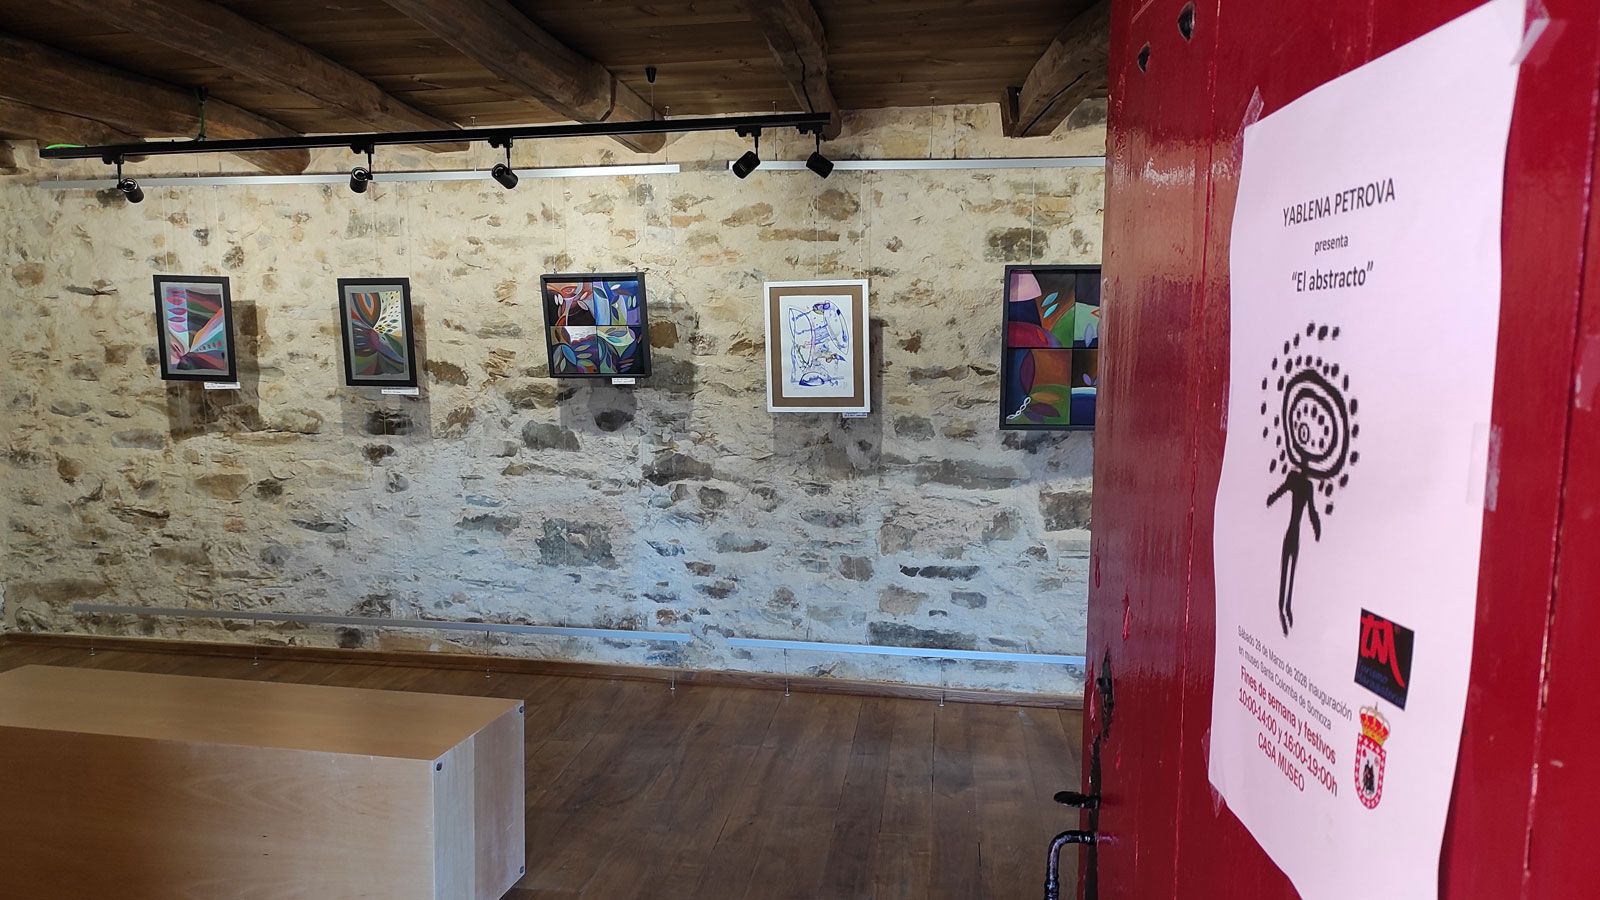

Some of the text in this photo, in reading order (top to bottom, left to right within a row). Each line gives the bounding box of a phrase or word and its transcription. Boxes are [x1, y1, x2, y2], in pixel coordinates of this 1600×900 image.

[1283, 178, 1395, 227] YABLENA PETROVA
[1314, 234, 1349, 255] presenta
[1238, 645, 1244, 656] en
[1275, 673, 1297, 702] Colomba
[1299, 694, 1305, 709] de
[1307, 700, 1331, 730] Somoza
[1262, 645, 1268, 658] de
[1269, 648, 1284, 670] Marzo
[1285, 662, 1292, 677] de
[1308, 678, 1352, 721] inauguración
[1241, 665, 1336, 765] Fines de semana y festivos
[1277, 727, 1282, 744] y
[1258, 732, 1305, 792] CASA MUSEO
